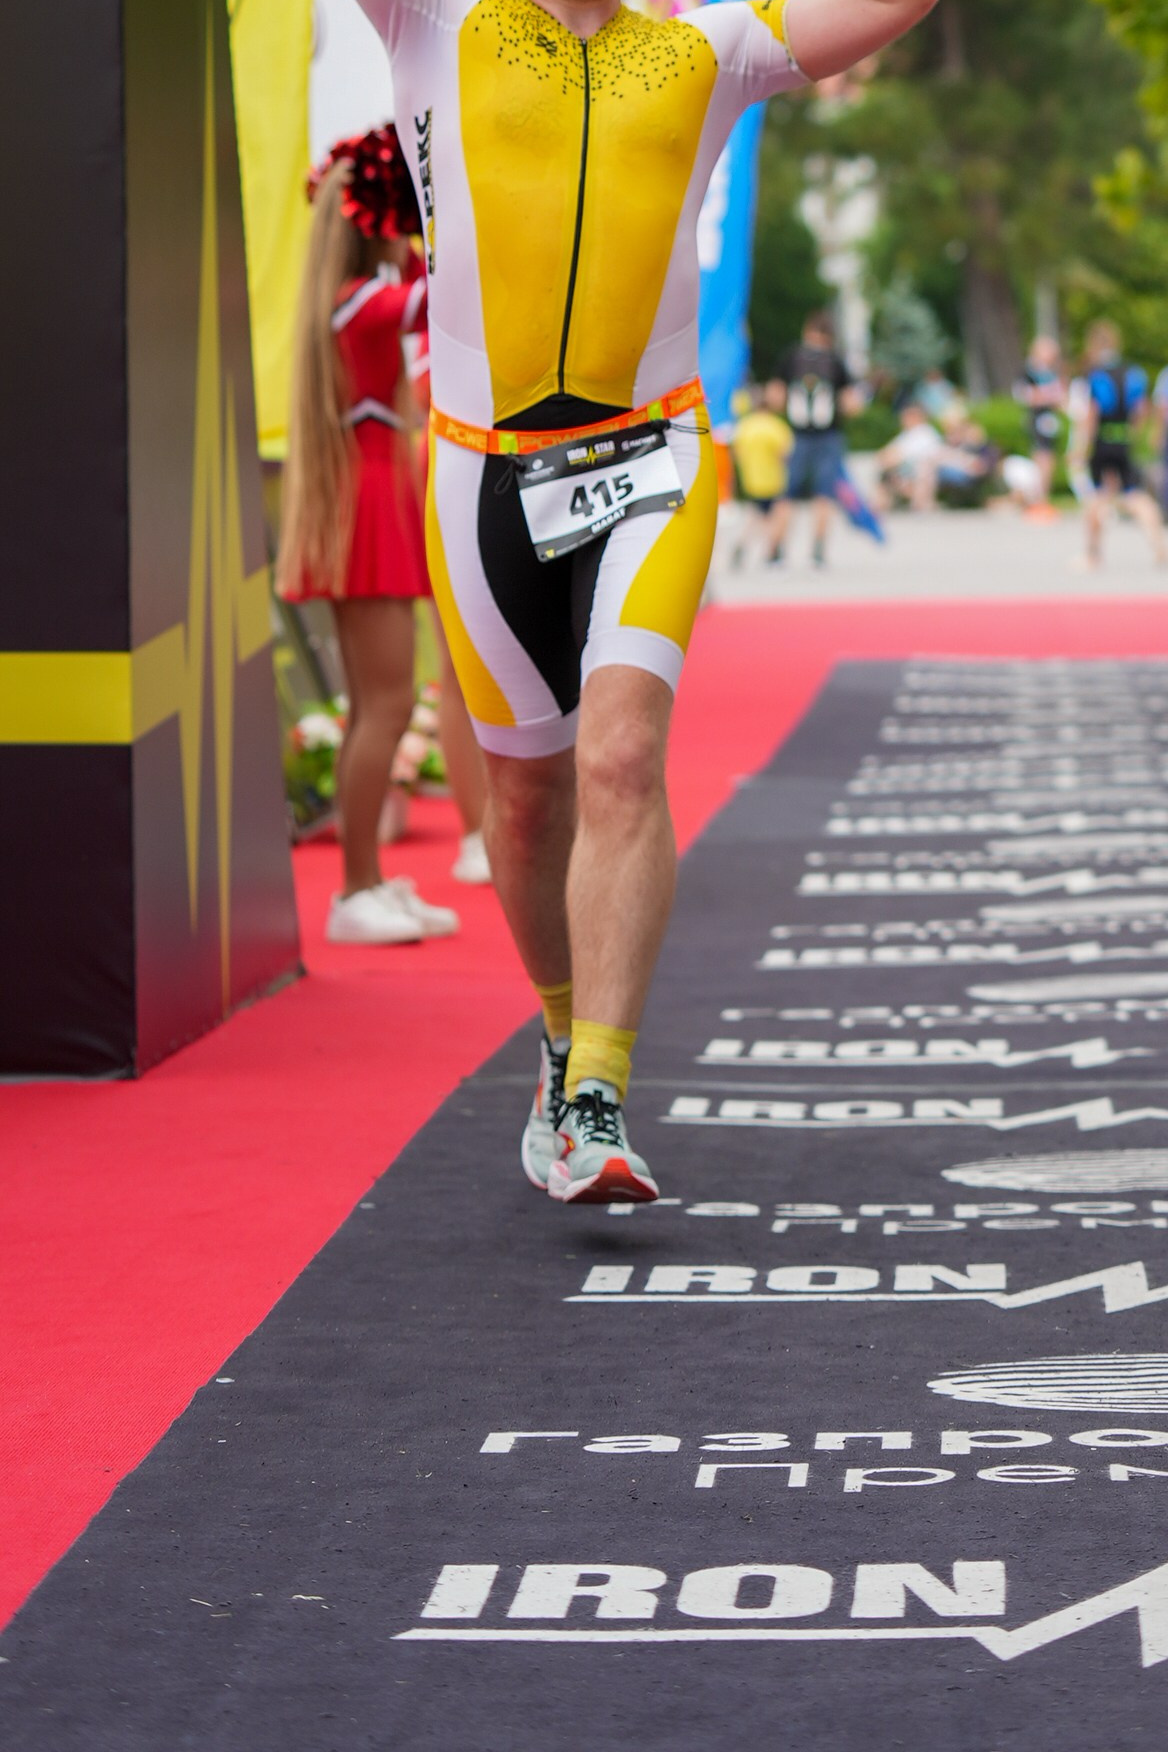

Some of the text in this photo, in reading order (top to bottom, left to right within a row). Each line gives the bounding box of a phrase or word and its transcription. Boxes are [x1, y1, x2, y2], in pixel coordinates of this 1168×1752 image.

[569, 471, 634, 518] 415
[581, 1262, 1007, 1294] IRON
[420, 1559, 1007, 1620] IRON
